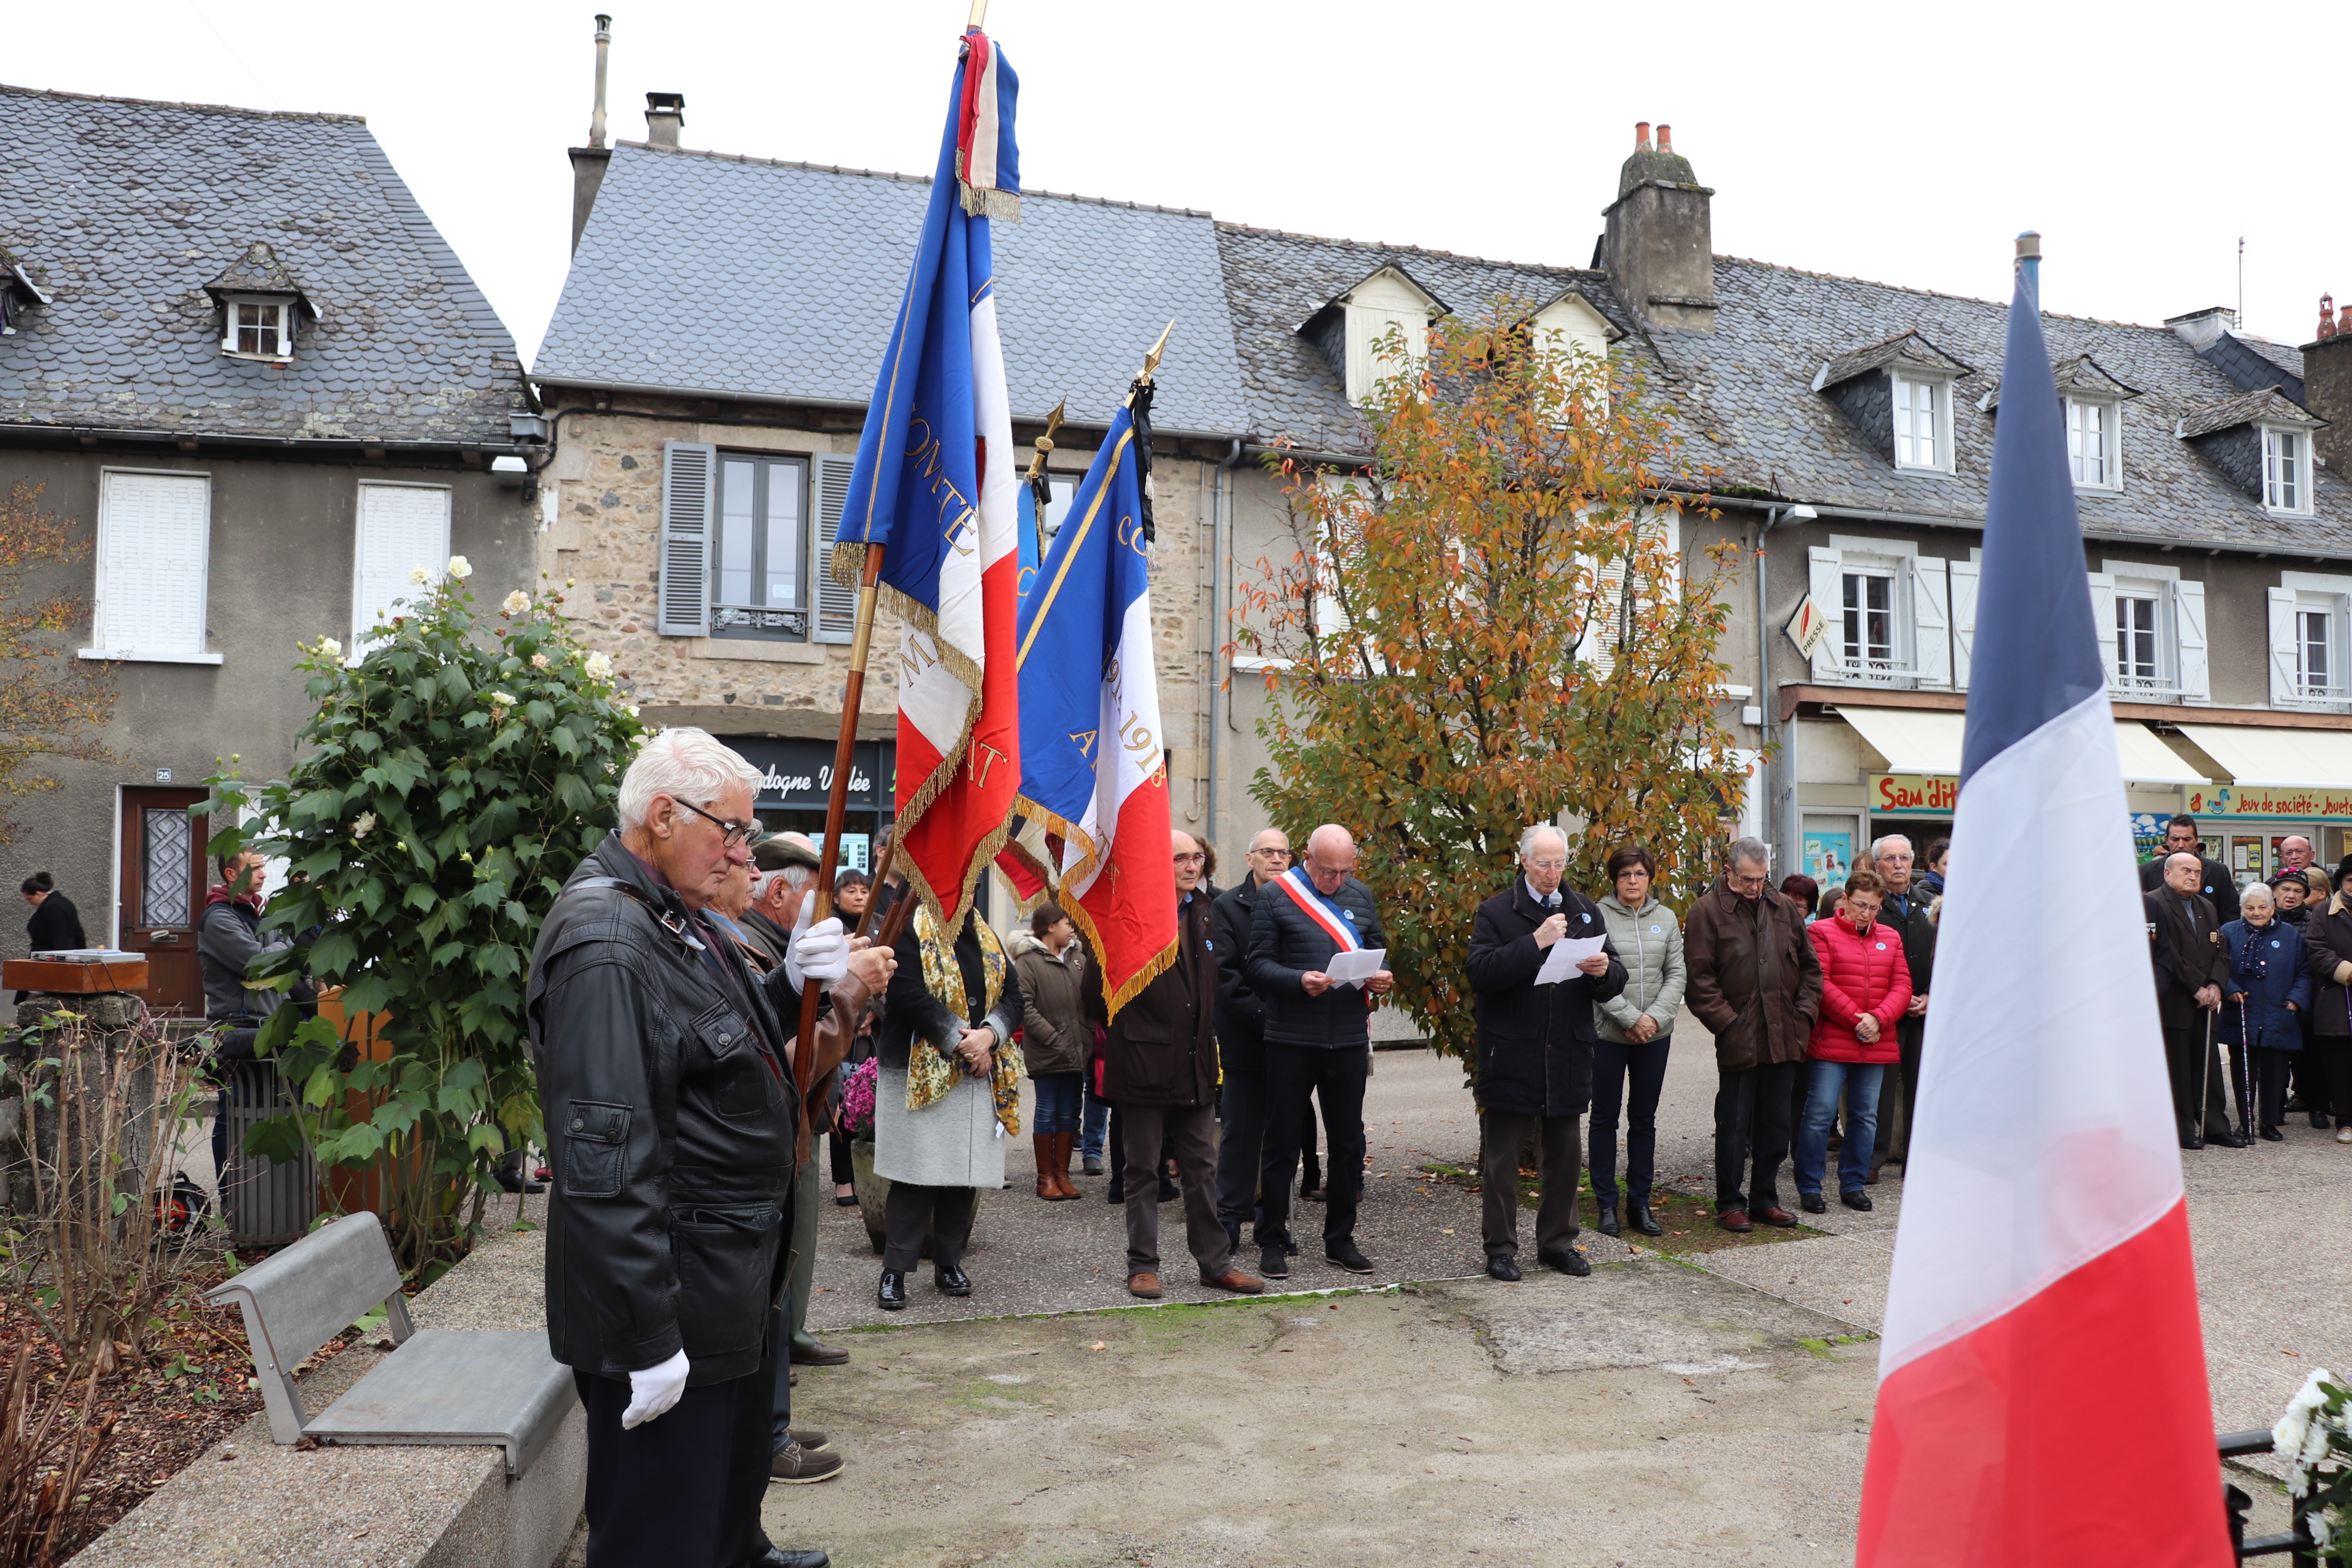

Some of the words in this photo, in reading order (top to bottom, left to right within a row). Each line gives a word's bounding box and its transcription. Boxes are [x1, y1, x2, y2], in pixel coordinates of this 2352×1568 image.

[1803, 619, 1825, 654] PRESSE
[900, 633, 939, 688] M
[1118, 710, 1167, 788] 1918
[158, 771, 169, 779] 25
[762, 763, 812, 800] dogne
[2236, 793, 2259, 814] Jeux
[2262, 792, 2273, 812] de
[2276, 794, 2312, 815] société
